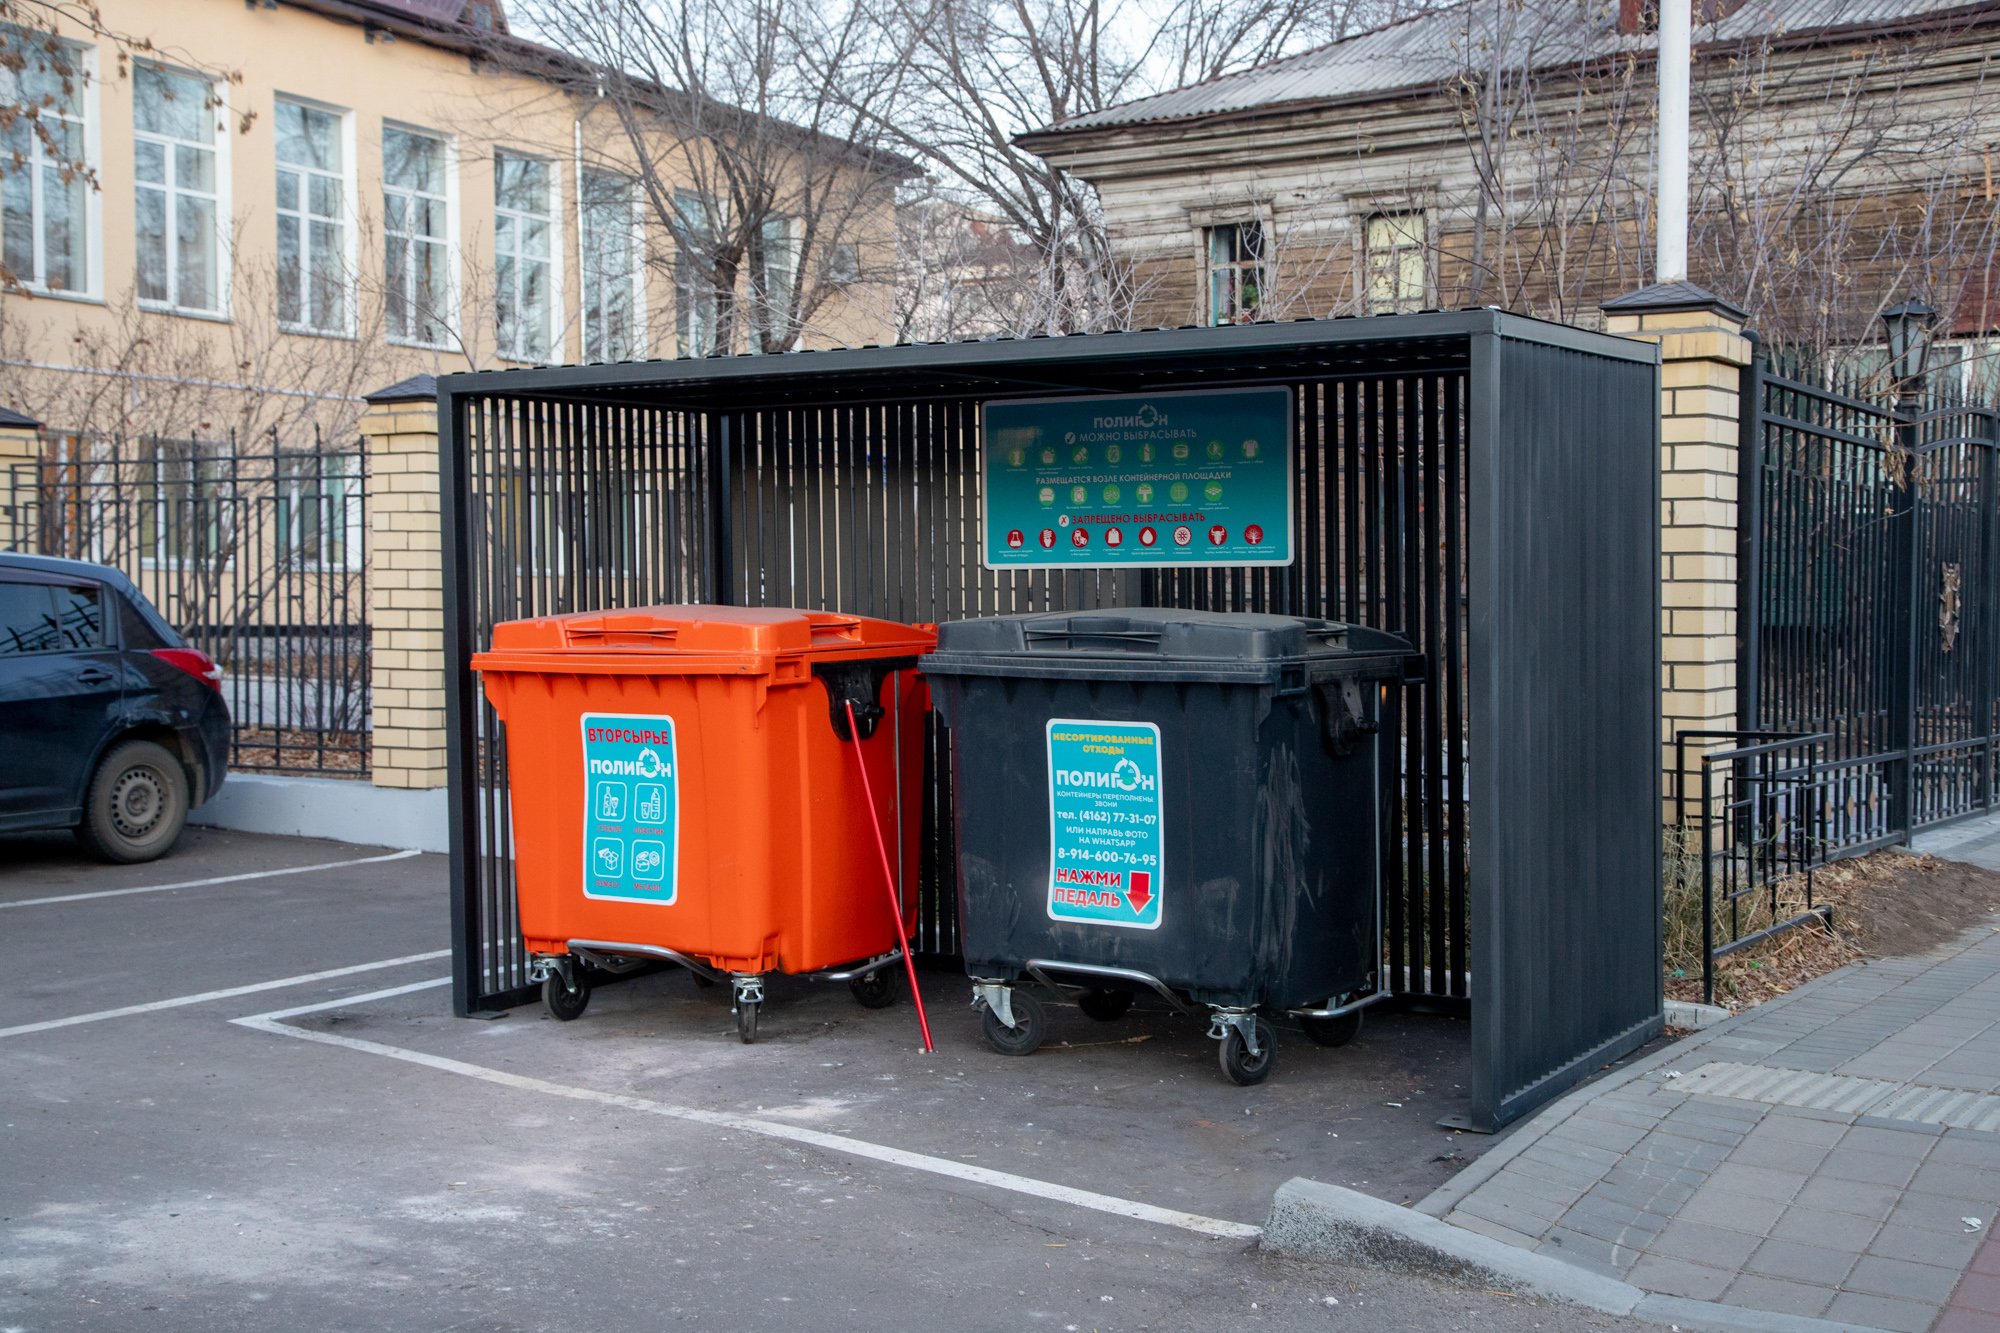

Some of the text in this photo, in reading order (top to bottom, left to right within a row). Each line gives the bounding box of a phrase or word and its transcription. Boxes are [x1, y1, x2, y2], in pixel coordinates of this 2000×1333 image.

[1079, 429, 1197, 443] МОЖНО ВЫБРАСЫВАТЬ
[1036, 471, 1232, 485] РАЗМЕЩАЕТСЯ ВОЗЛЕ КОНТЕЙНЕРНОЙ ПЛОЩАДКИ
[1072, 512, 1205, 526] ЗАПРЕЩЕНО ВЫБРАСЫВАТЬ
[587, 728, 669, 745] ВТОРСЫРЬЕ
[1053, 732, 1154, 745] НЕСОРТИРОВАННЫЕ
[1082, 745, 1124, 755] ОТХОДЫ
[1057, 791, 1153, 803] КОНТЕЙНЕРЫ ПЕРЕПОЛНЕНЫ
[1094, 800, 1118, 808] ЗВОНИ
[1057, 810, 1156, 825] тел. (4162) 77-31-07
[1066, 826, 1148, 839] ИЛИ НАПРАВЬ ФОТО
[1079, 837, 1136, 848] НА WHATSAPP
[1058, 848, 1157, 866] 8-914-600-76-95
[1056, 867, 1122, 887] НАЖМИ
[1054, 887, 1122, 909] ПЕДАЛЬ
